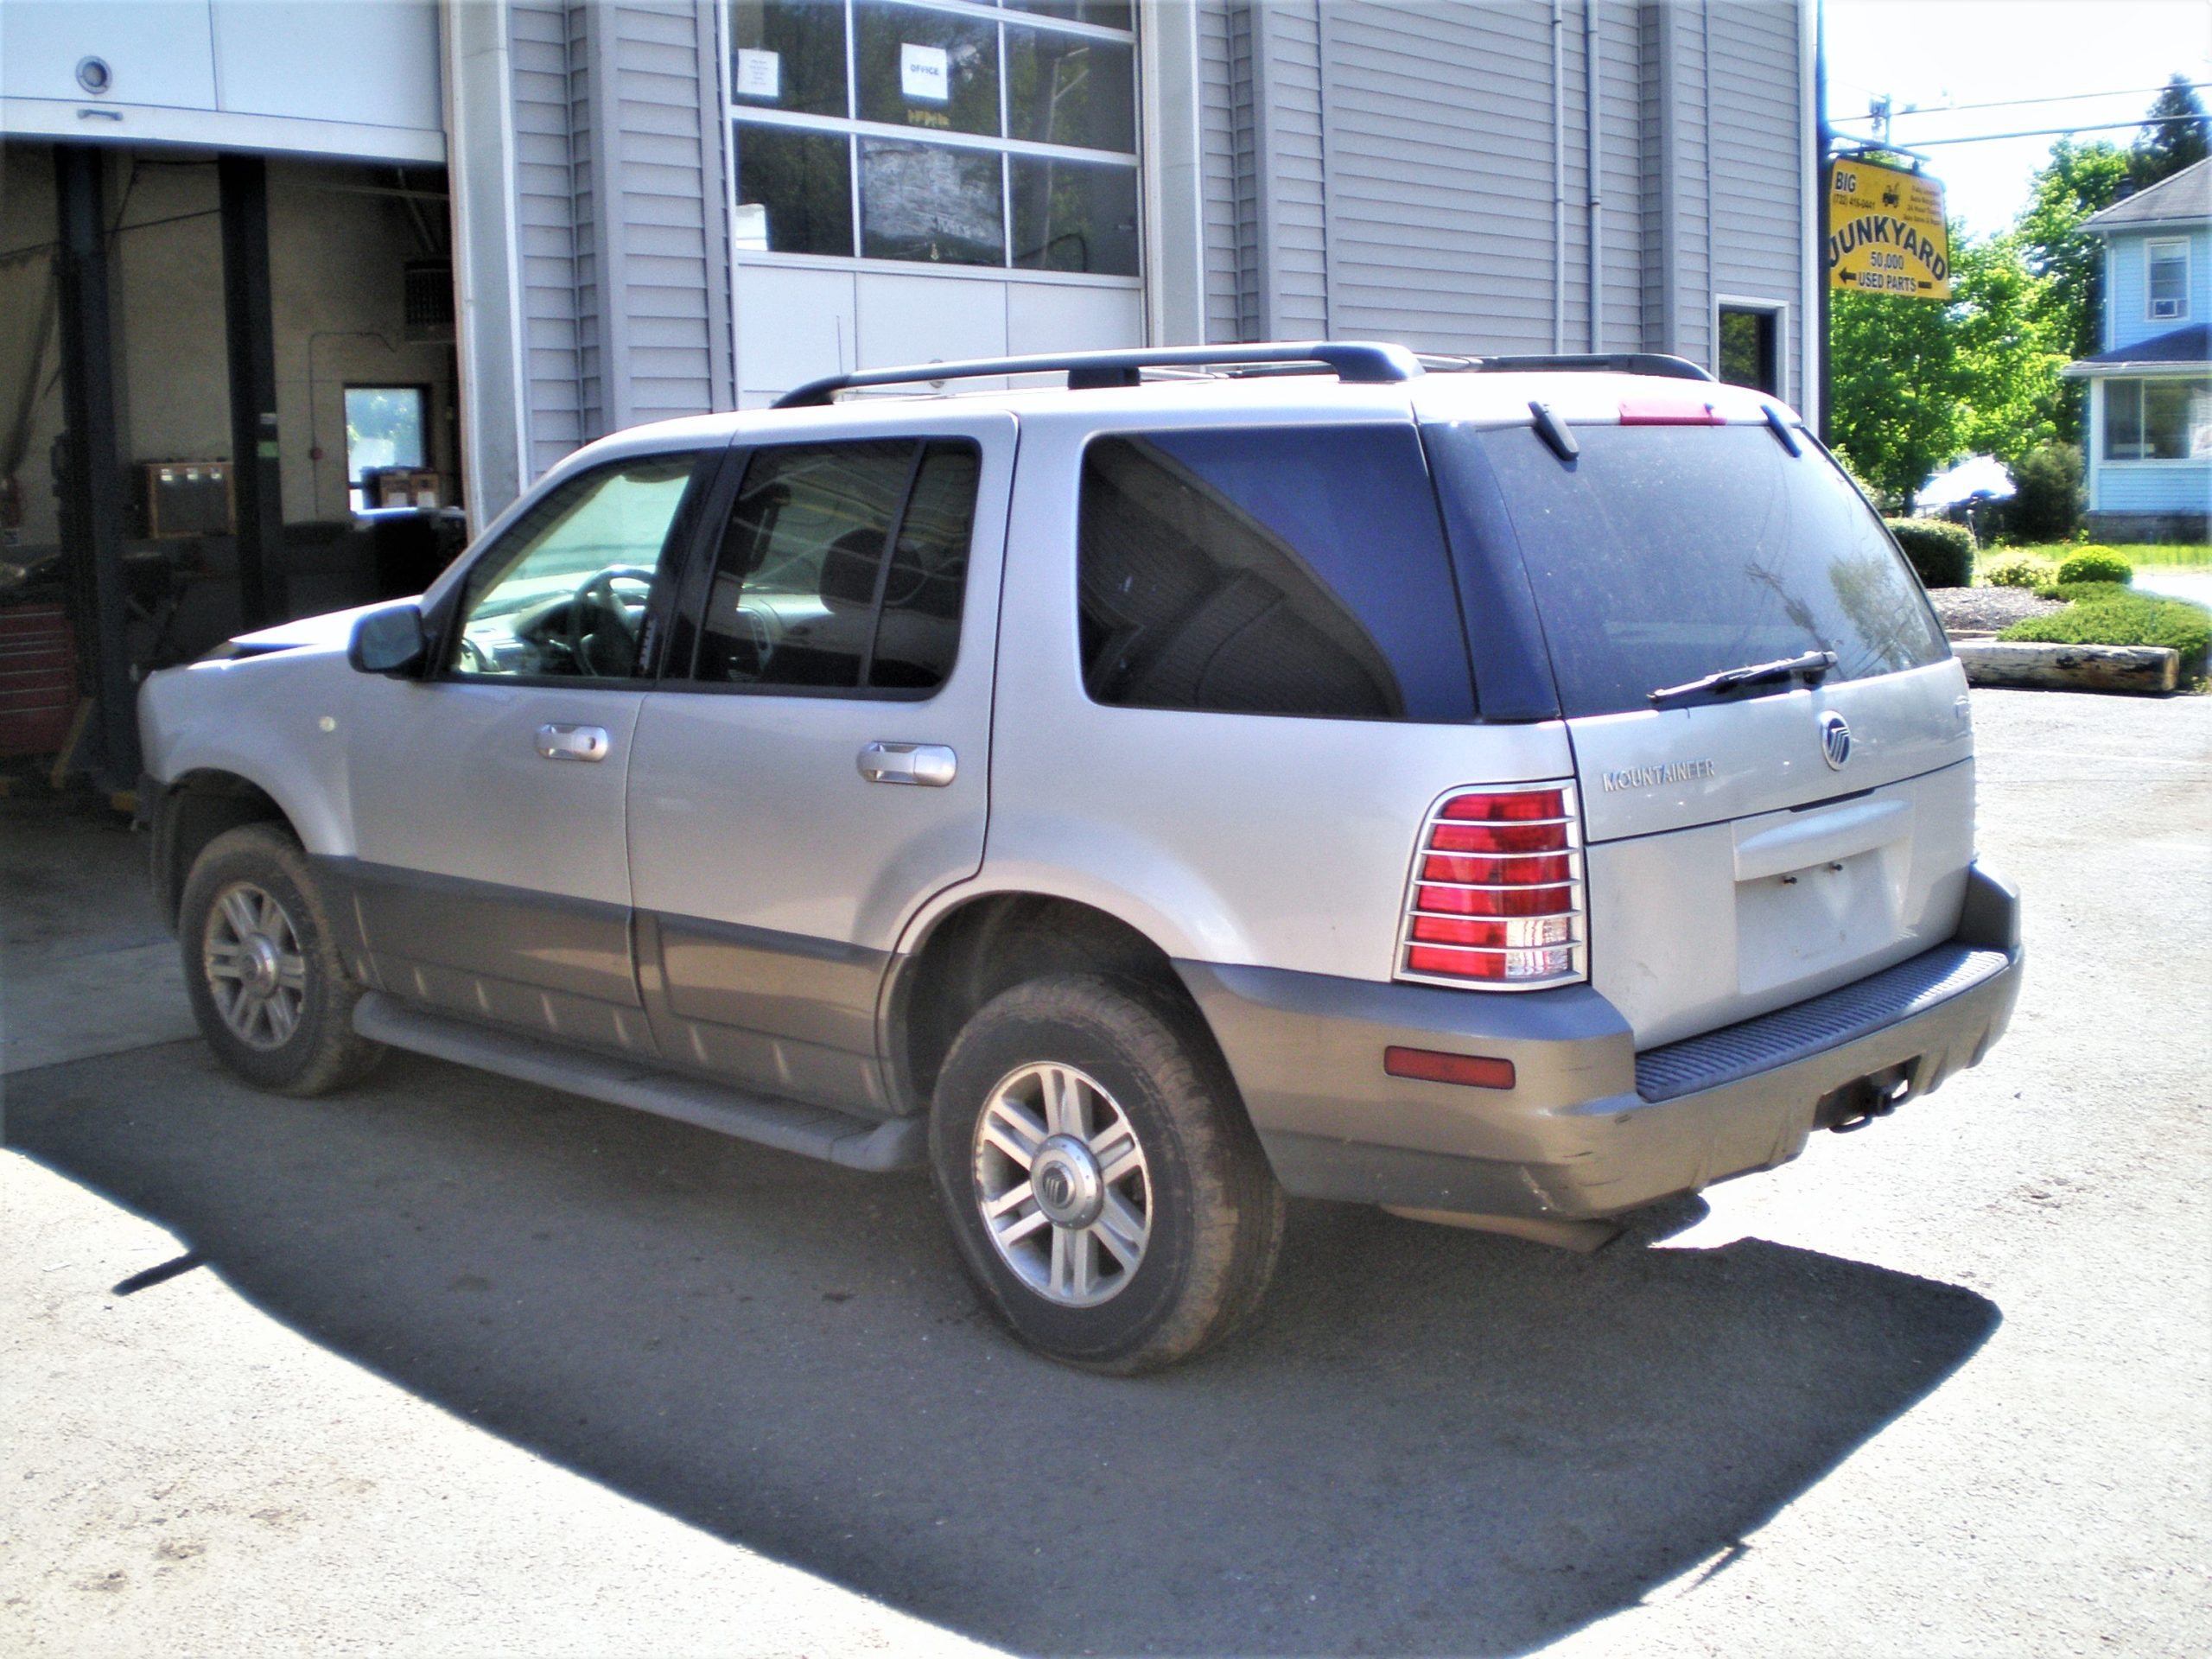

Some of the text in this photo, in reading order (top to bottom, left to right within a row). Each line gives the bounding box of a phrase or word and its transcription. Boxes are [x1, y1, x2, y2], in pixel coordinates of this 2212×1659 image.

[910, 63, 939, 76] OFFICE
[1835, 171, 1856, 193] BIG
[1829, 215, 1946, 281] JUNKYARD
[1871, 251, 1904, 270] 50,000
[1859, 271, 1916, 292] USED PARTS
[1602, 758, 1715, 792] MOUNTAINEER
